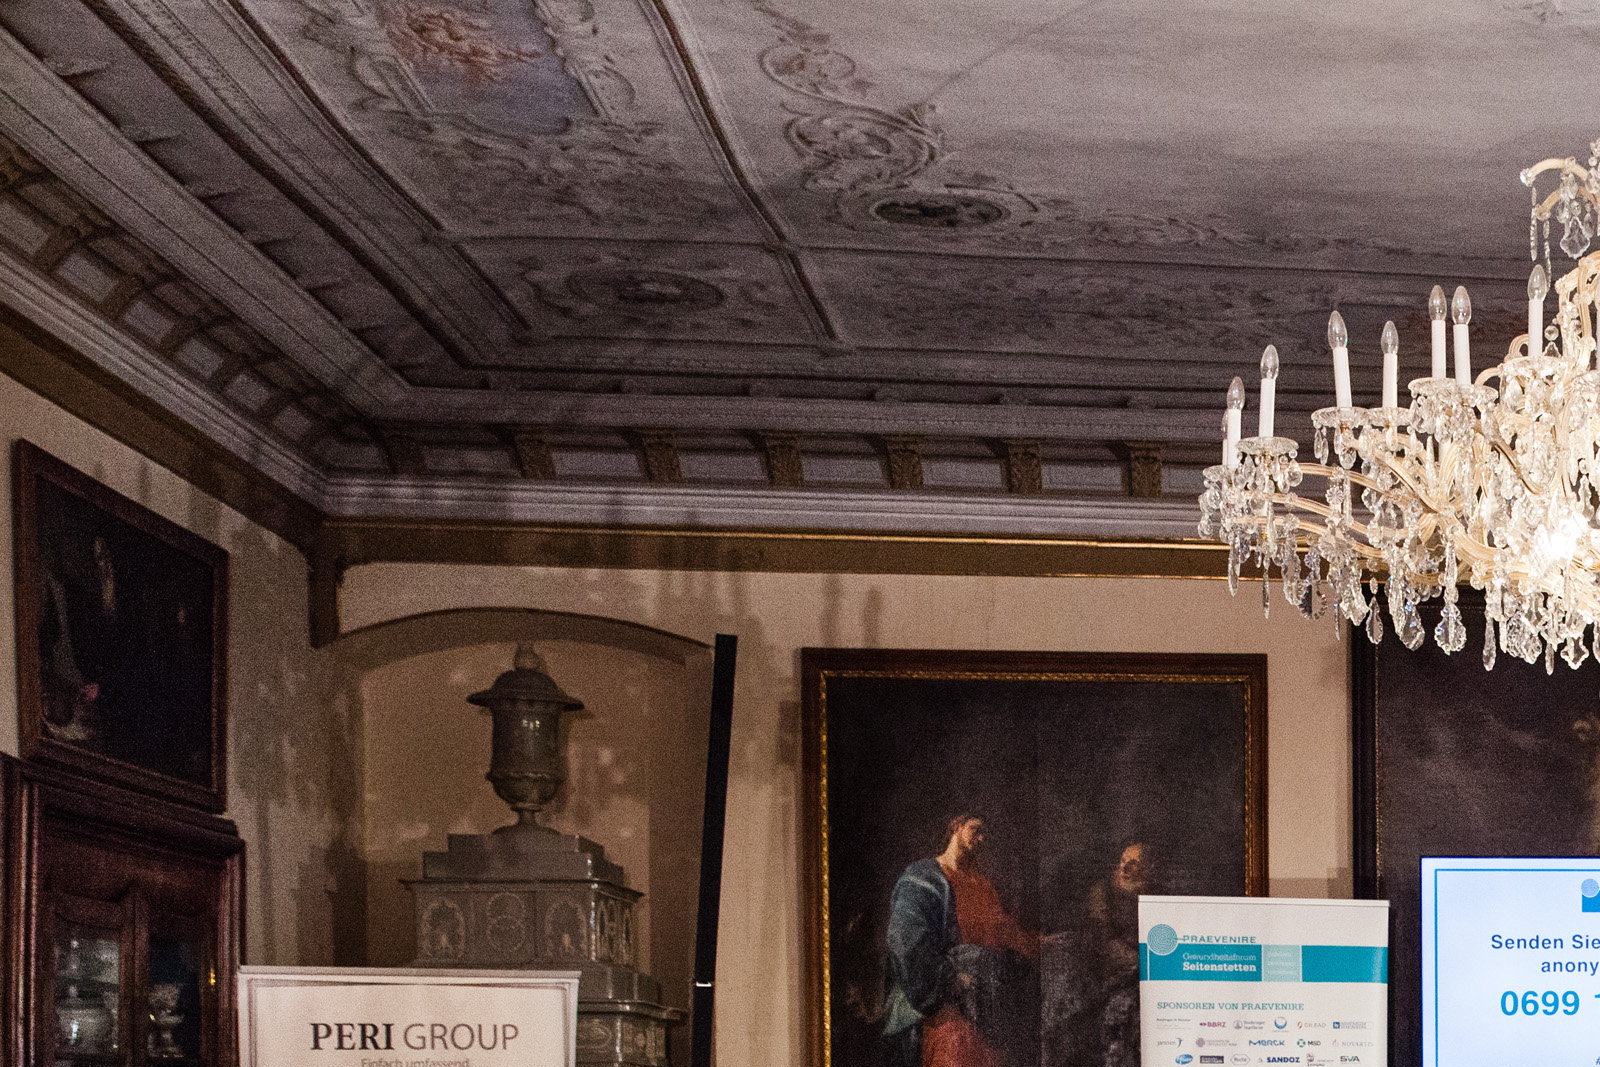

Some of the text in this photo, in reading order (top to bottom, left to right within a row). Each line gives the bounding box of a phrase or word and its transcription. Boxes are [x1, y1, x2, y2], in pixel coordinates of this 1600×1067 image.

[1183, 935, 1257, 944] PRAEVENIRE
[1491, 934, 1564, 950] Senden
[1571, 934, 1600, 950] Sie
[1182, 953, 1257, 961] Gesundheitsforum
[1182, 962, 1257, 972] Seitenstetten
[1157, 1001, 1305, 1011] SPONSOREN VON PRAEVENIRE
[1501, 990, 1580, 1016] 0699
[309, 1022, 520, 1051] PERI GROUP
